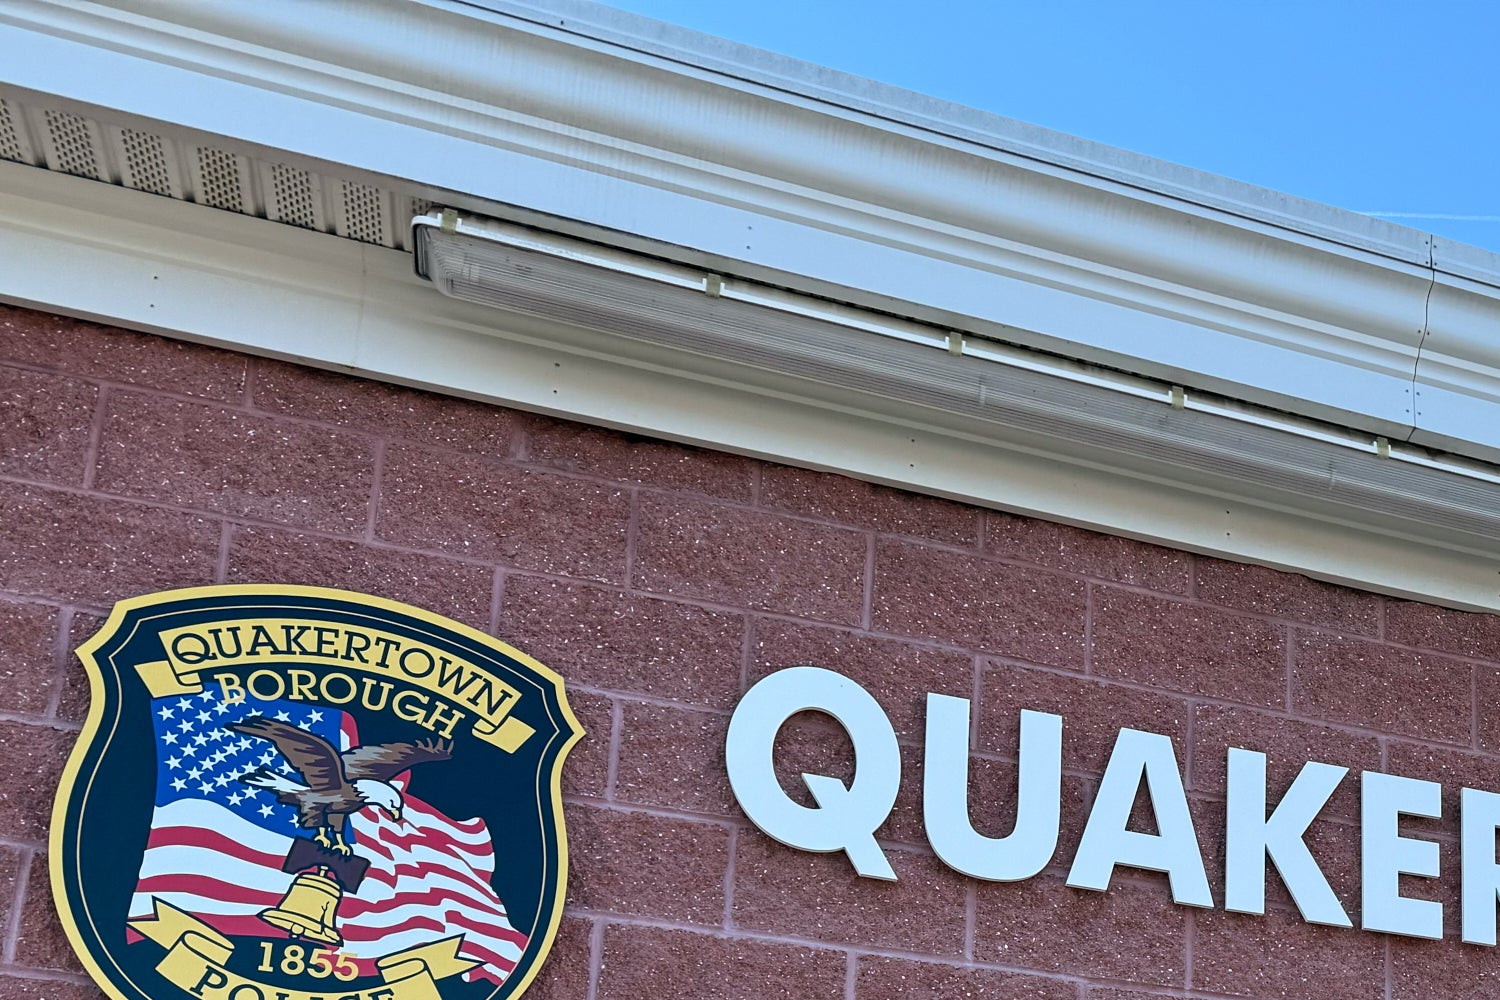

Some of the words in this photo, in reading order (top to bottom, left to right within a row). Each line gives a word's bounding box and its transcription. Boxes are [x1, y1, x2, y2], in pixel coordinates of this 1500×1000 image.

[171, 624, 512, 715] QUAKERTOWN
[213, 669, 466, 740] BOROUGH
[256, 941, 360, 982] 1855
